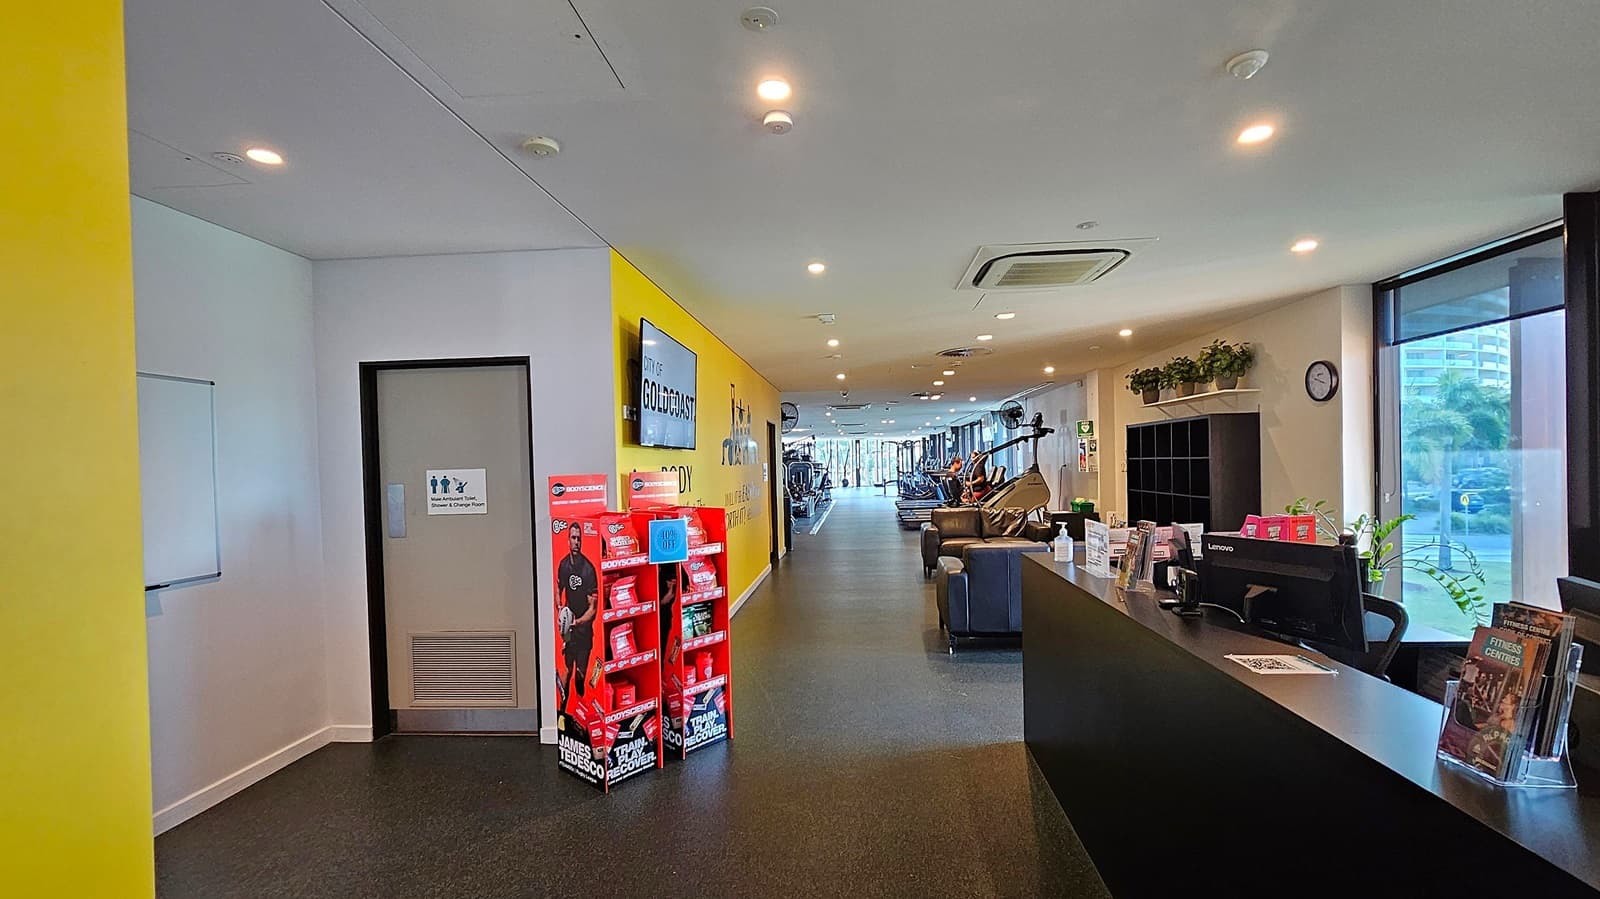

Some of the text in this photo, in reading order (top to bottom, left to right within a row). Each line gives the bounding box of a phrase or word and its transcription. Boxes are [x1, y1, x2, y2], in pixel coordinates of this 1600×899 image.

[644, 356, 663, 376] CITY OF
[1208, 543, 1234, 551] Lenovo
[1503, 619, 1529, 631] FITNESS
[1489, 637, 1522, 655] FITNESS
[1485, 648, 1520, 666] CENTRES
[605, 701, 655, 723] BODYSCIENCE
[690, 709, 719, 727] TRAIN.
[684, 724, 727, 748] RECOVER.
[694, 719, 717, 735] PLAY.
[559, 734, 591, 760] JAMES
[613, 737, 648, 757] TRAIN.
[617, 747, 645, 766] PLAY.
[559, 746, 605, 779] TEDESCO
[607, 752, 657, 780] RECOVER.
